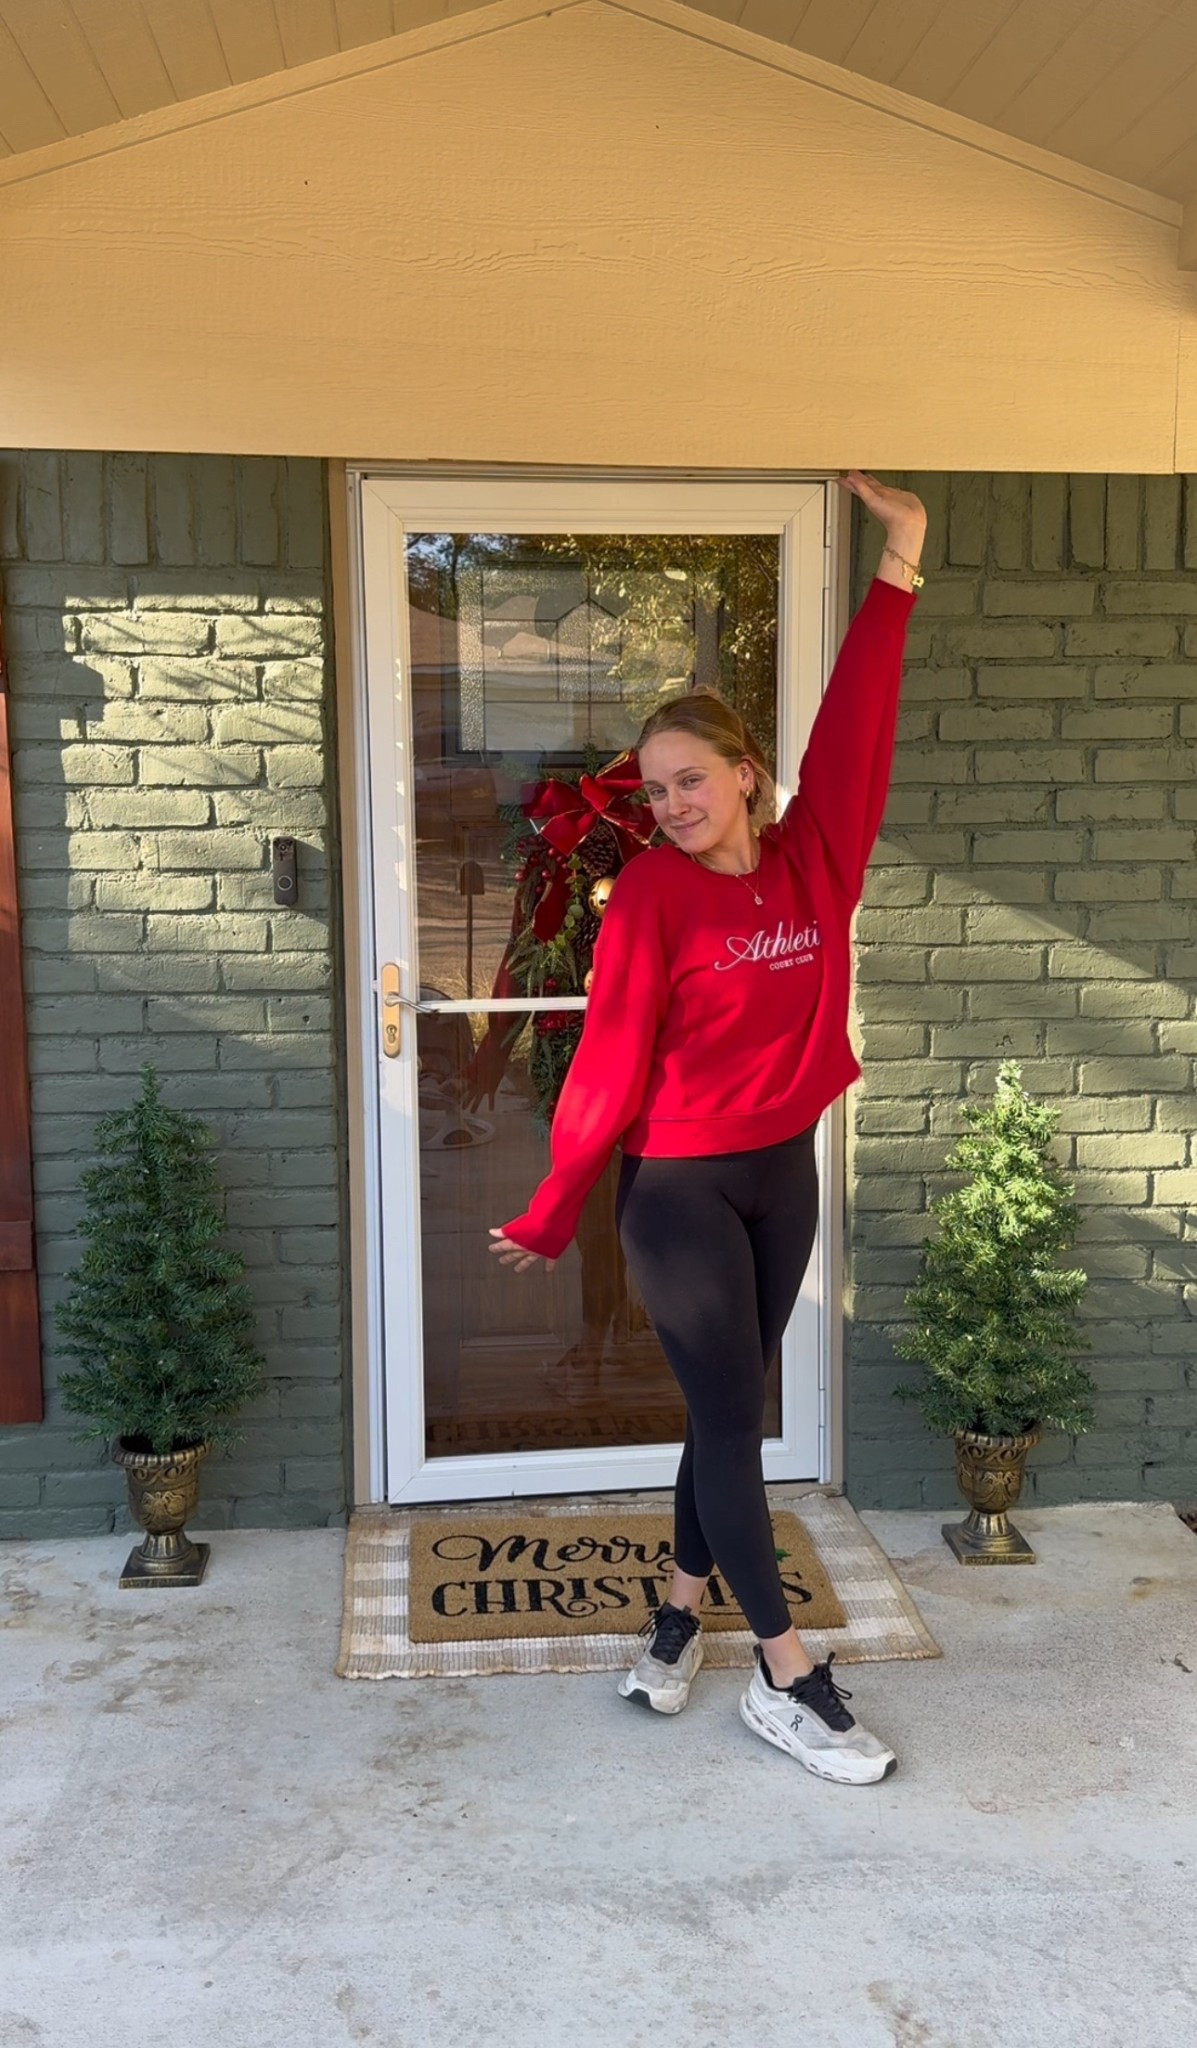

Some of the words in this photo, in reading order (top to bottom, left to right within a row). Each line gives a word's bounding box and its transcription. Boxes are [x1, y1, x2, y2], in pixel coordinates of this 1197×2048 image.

[769, 958, 794, 971] COURT
[795, 953, 815, 965] CLUB
[431, 1571, 812, 1618] CHRISTS
